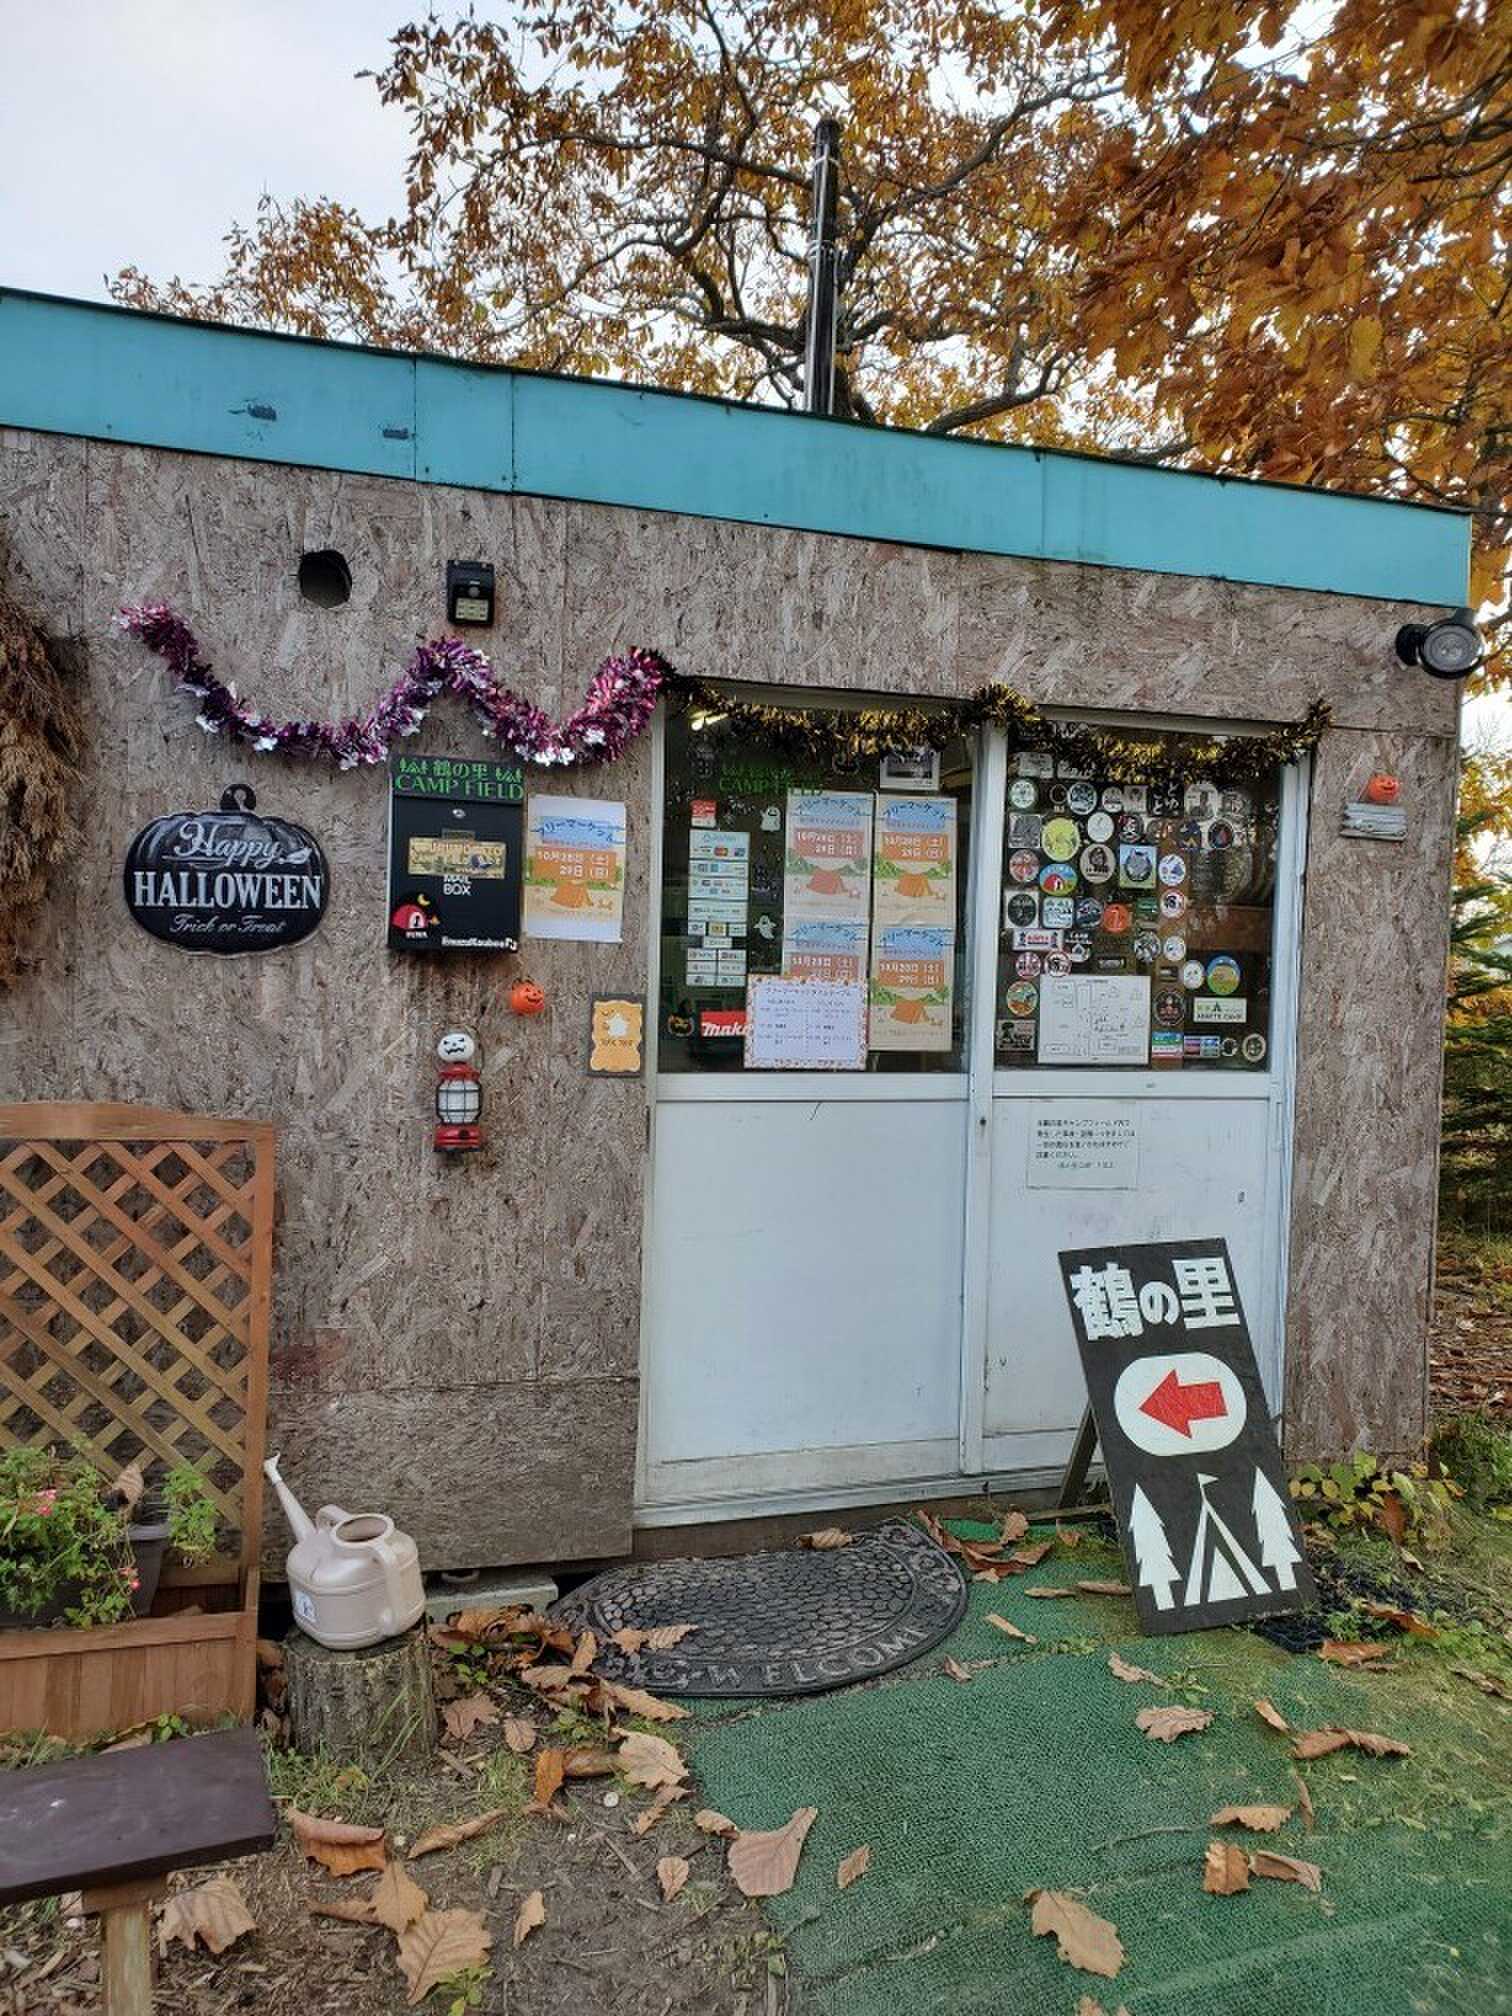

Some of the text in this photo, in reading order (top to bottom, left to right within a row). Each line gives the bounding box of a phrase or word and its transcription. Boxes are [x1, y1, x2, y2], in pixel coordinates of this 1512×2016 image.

[395, 774, 524, 800] CAMP FIELD
[174, 820, 283, 870] Happy
[133, 871, 321, 909] HALLOWEEN
[443, 883, 473, 896] BOX
[169, 912, 287, 934] Trick or Treat
[1069, 1257, 1241, 1342] 鶴の里
